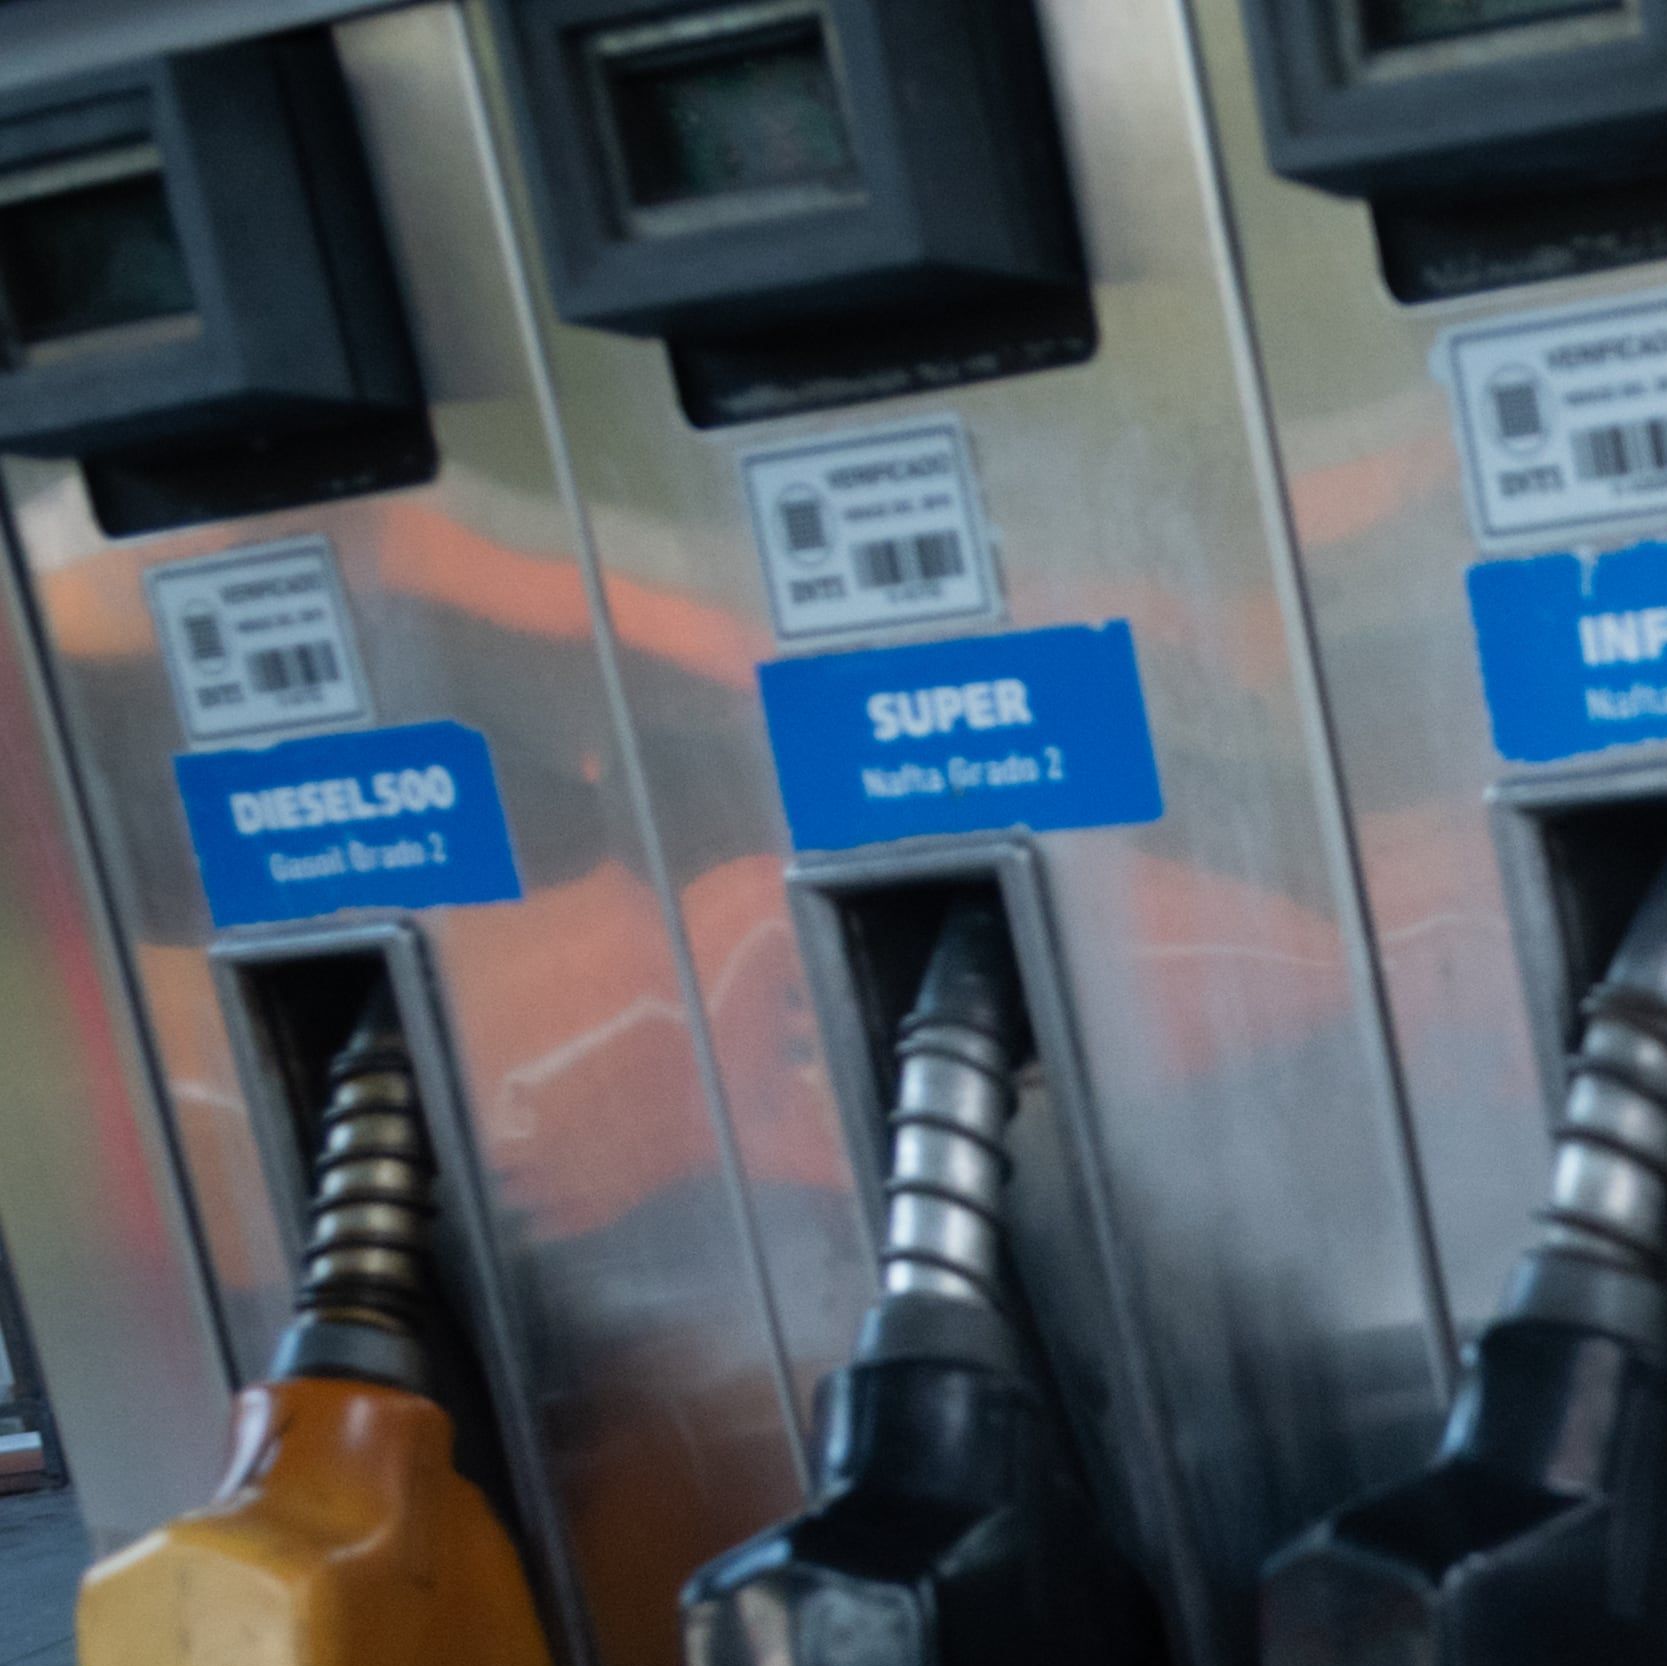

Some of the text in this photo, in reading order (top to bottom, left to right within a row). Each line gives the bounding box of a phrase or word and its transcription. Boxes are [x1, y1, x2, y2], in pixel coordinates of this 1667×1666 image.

[865, 678, 1033, 742] SUPER
[861, 745, 1064, 798] Nafta Grado 2
[427, 831, 448, 865] 2
